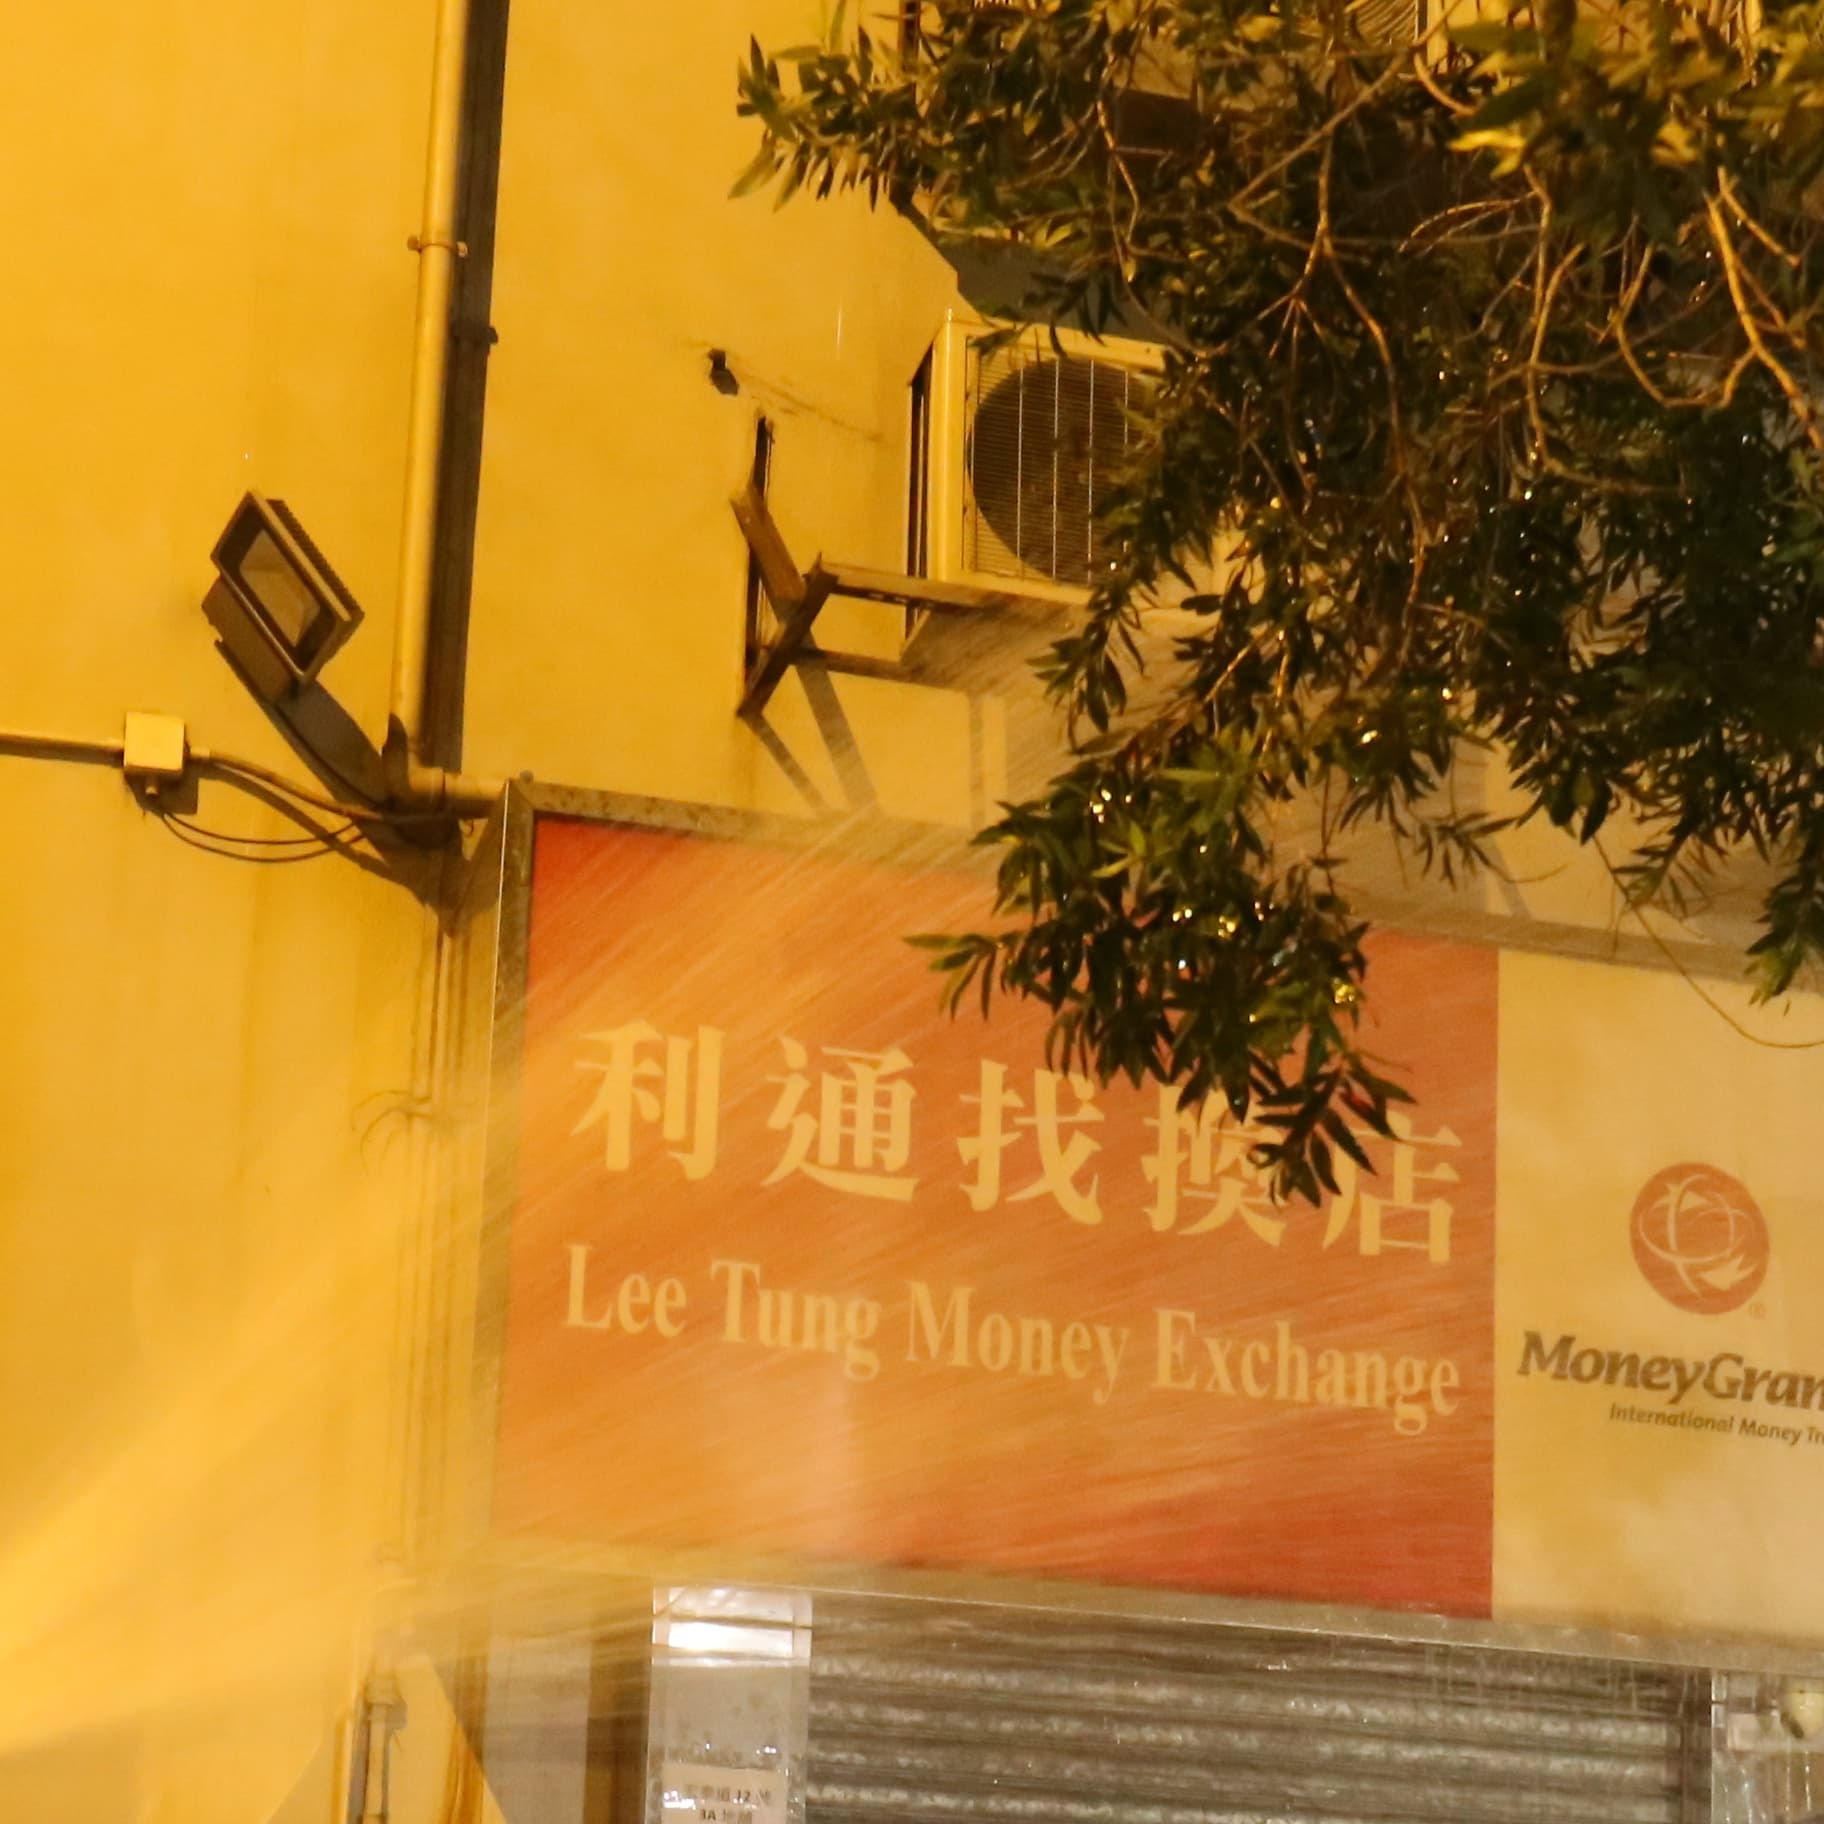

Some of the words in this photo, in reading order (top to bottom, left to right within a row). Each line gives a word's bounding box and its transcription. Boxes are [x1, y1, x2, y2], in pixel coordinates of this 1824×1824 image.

[570, 1018, 1463, 1264] 利通找換店
[563, 1244, 688, 1339] Lee
[709, 1258, 882, 1382] Tung
[904, 1280, 1131, 1406] Money
[1151, 1306, 1461, 1437] Exchange
[1608, 1401, 1736, 1435] International
[1738, 1417, 1803, 1447] Money
